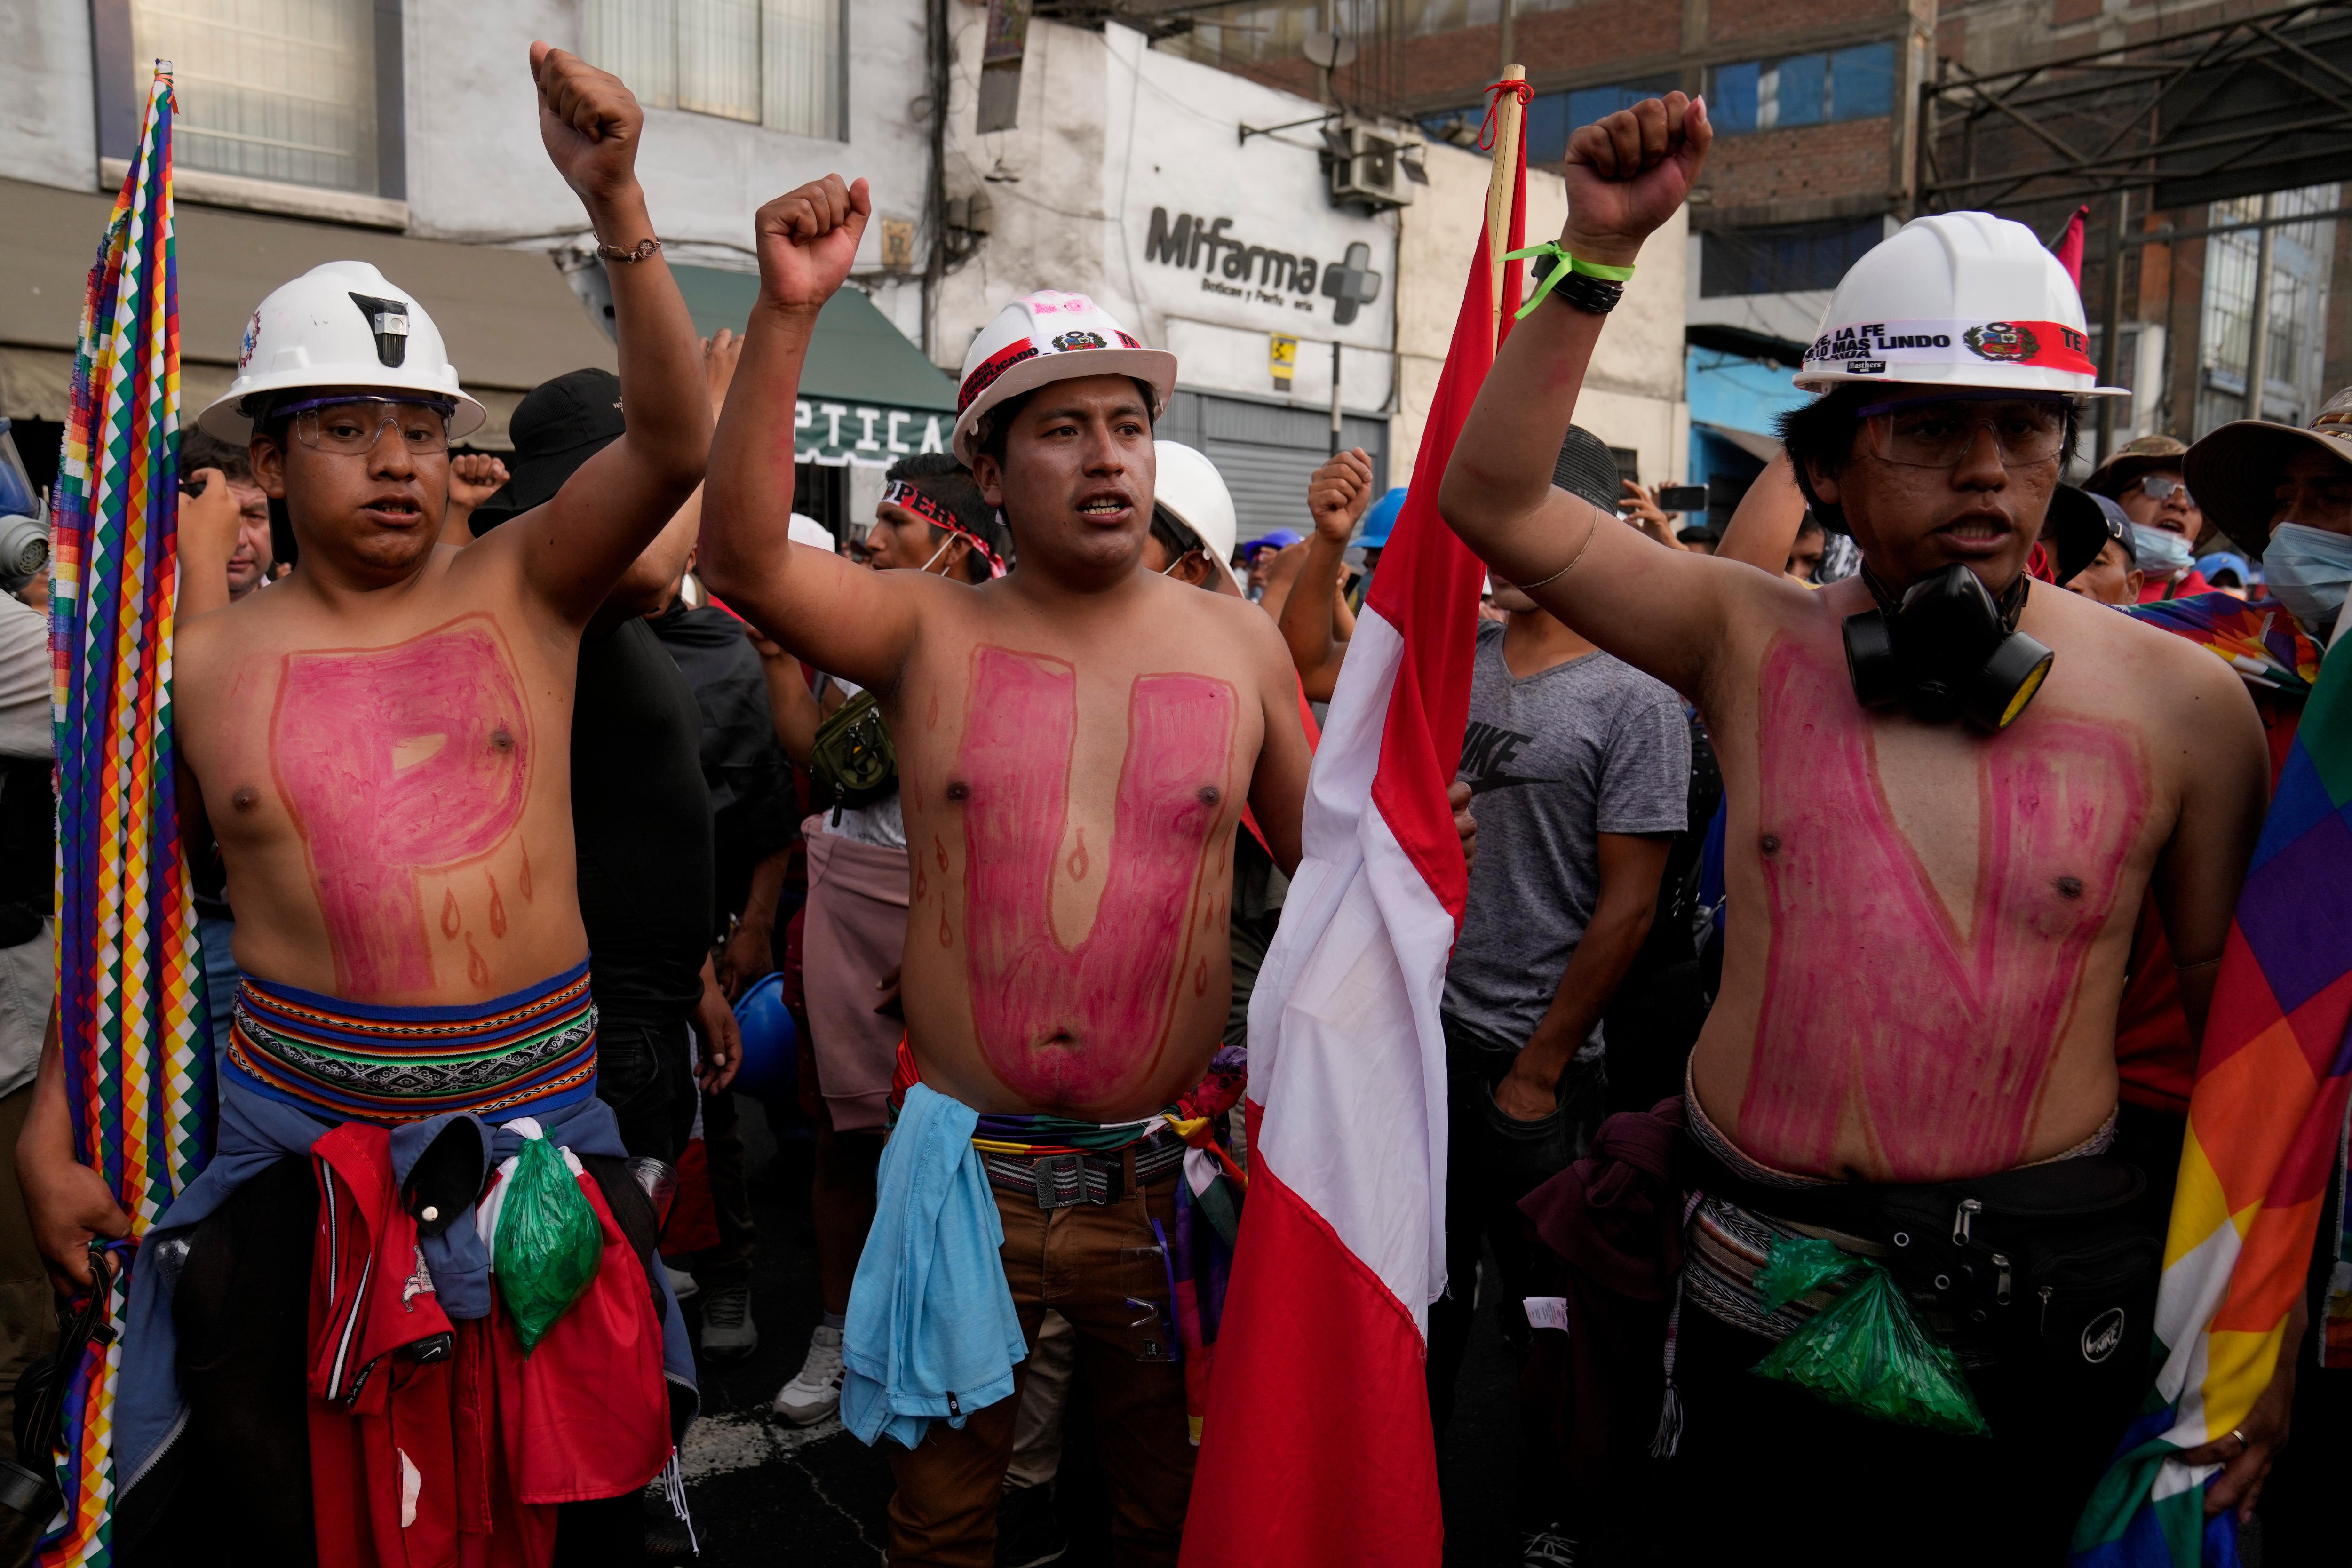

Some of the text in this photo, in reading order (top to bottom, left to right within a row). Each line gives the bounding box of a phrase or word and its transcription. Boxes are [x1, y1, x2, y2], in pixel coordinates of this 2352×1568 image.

[1146, 207, 1317, 295] Mifarma
[1832, 338, 1870, 354] MAS
[1878, 335, 1950, 350] LINDO
[1836, 327, 1855, 341] LA
[1861, 324, 1884, 337] FE
[2059, 326, 2082, 353] TE
[965, 347, 1039, 399] COMPLICADO
[269, 611, 535, 995] P
[957, 642, 1239, 1105] U
